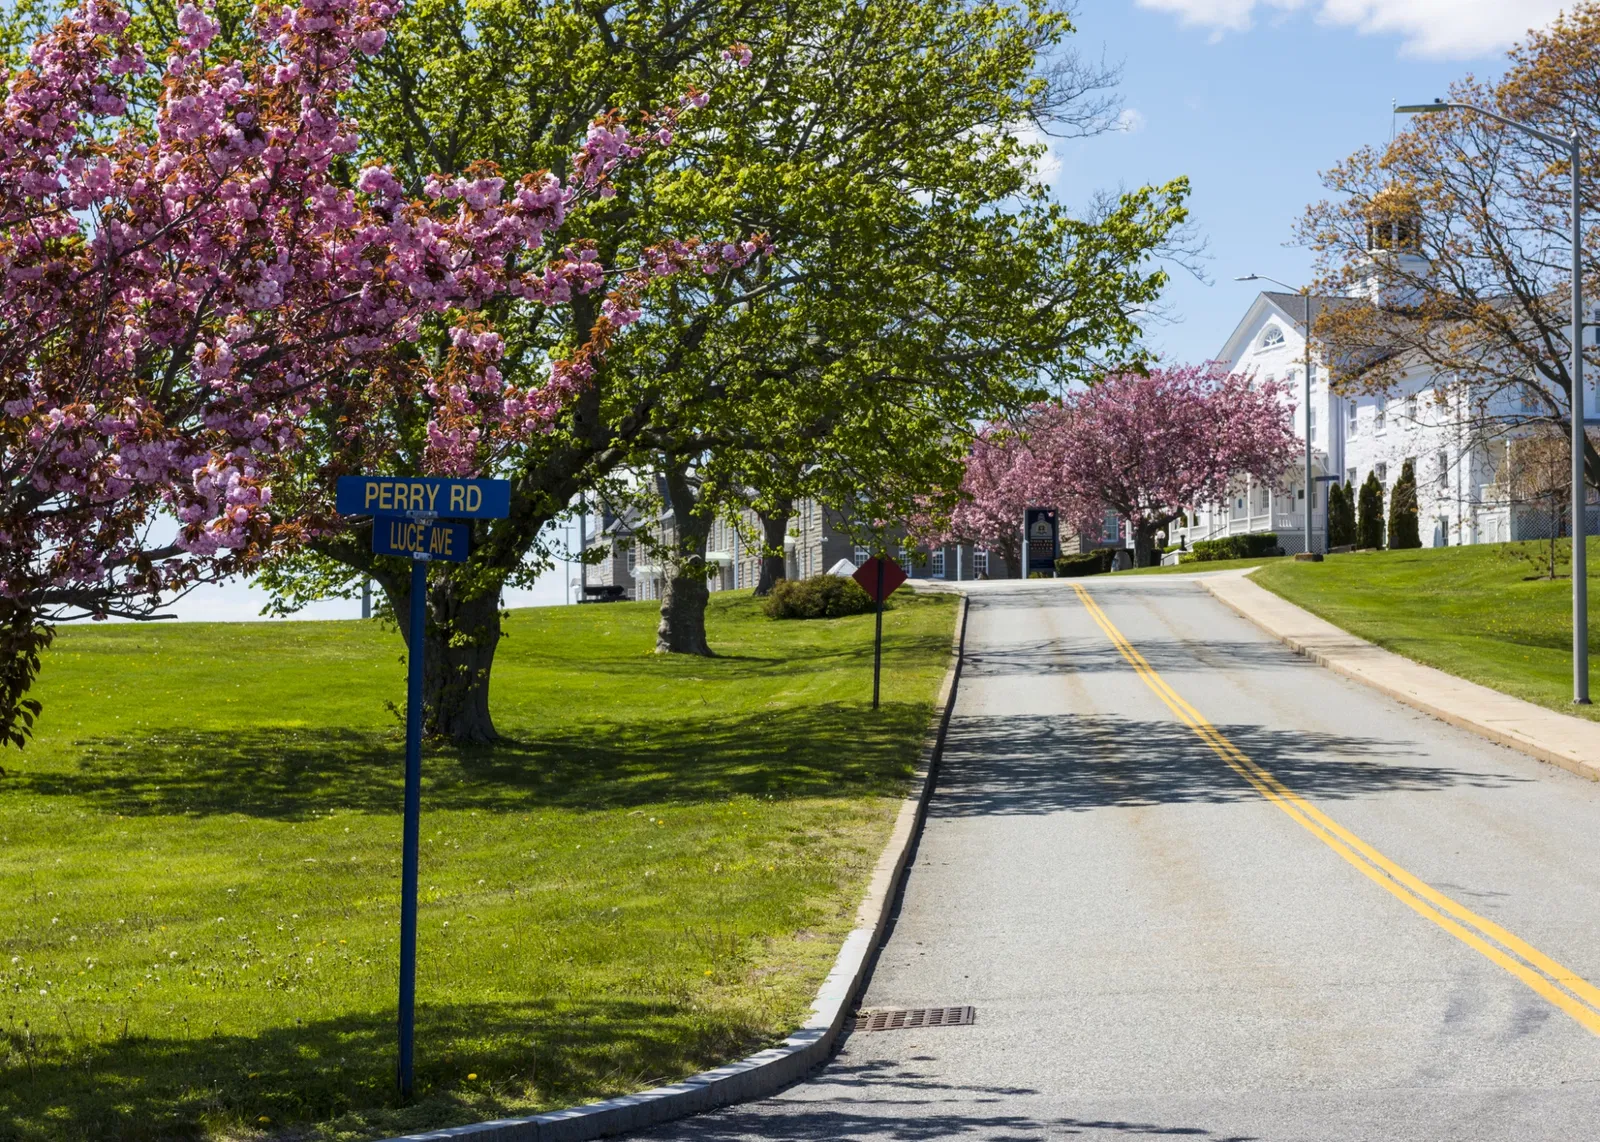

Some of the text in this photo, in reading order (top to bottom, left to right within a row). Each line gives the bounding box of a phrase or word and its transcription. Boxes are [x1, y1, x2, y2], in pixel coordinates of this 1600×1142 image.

[365, 482, 482, 512] PERRY RD
[390, 521, 453, 555] LUCE AVE
